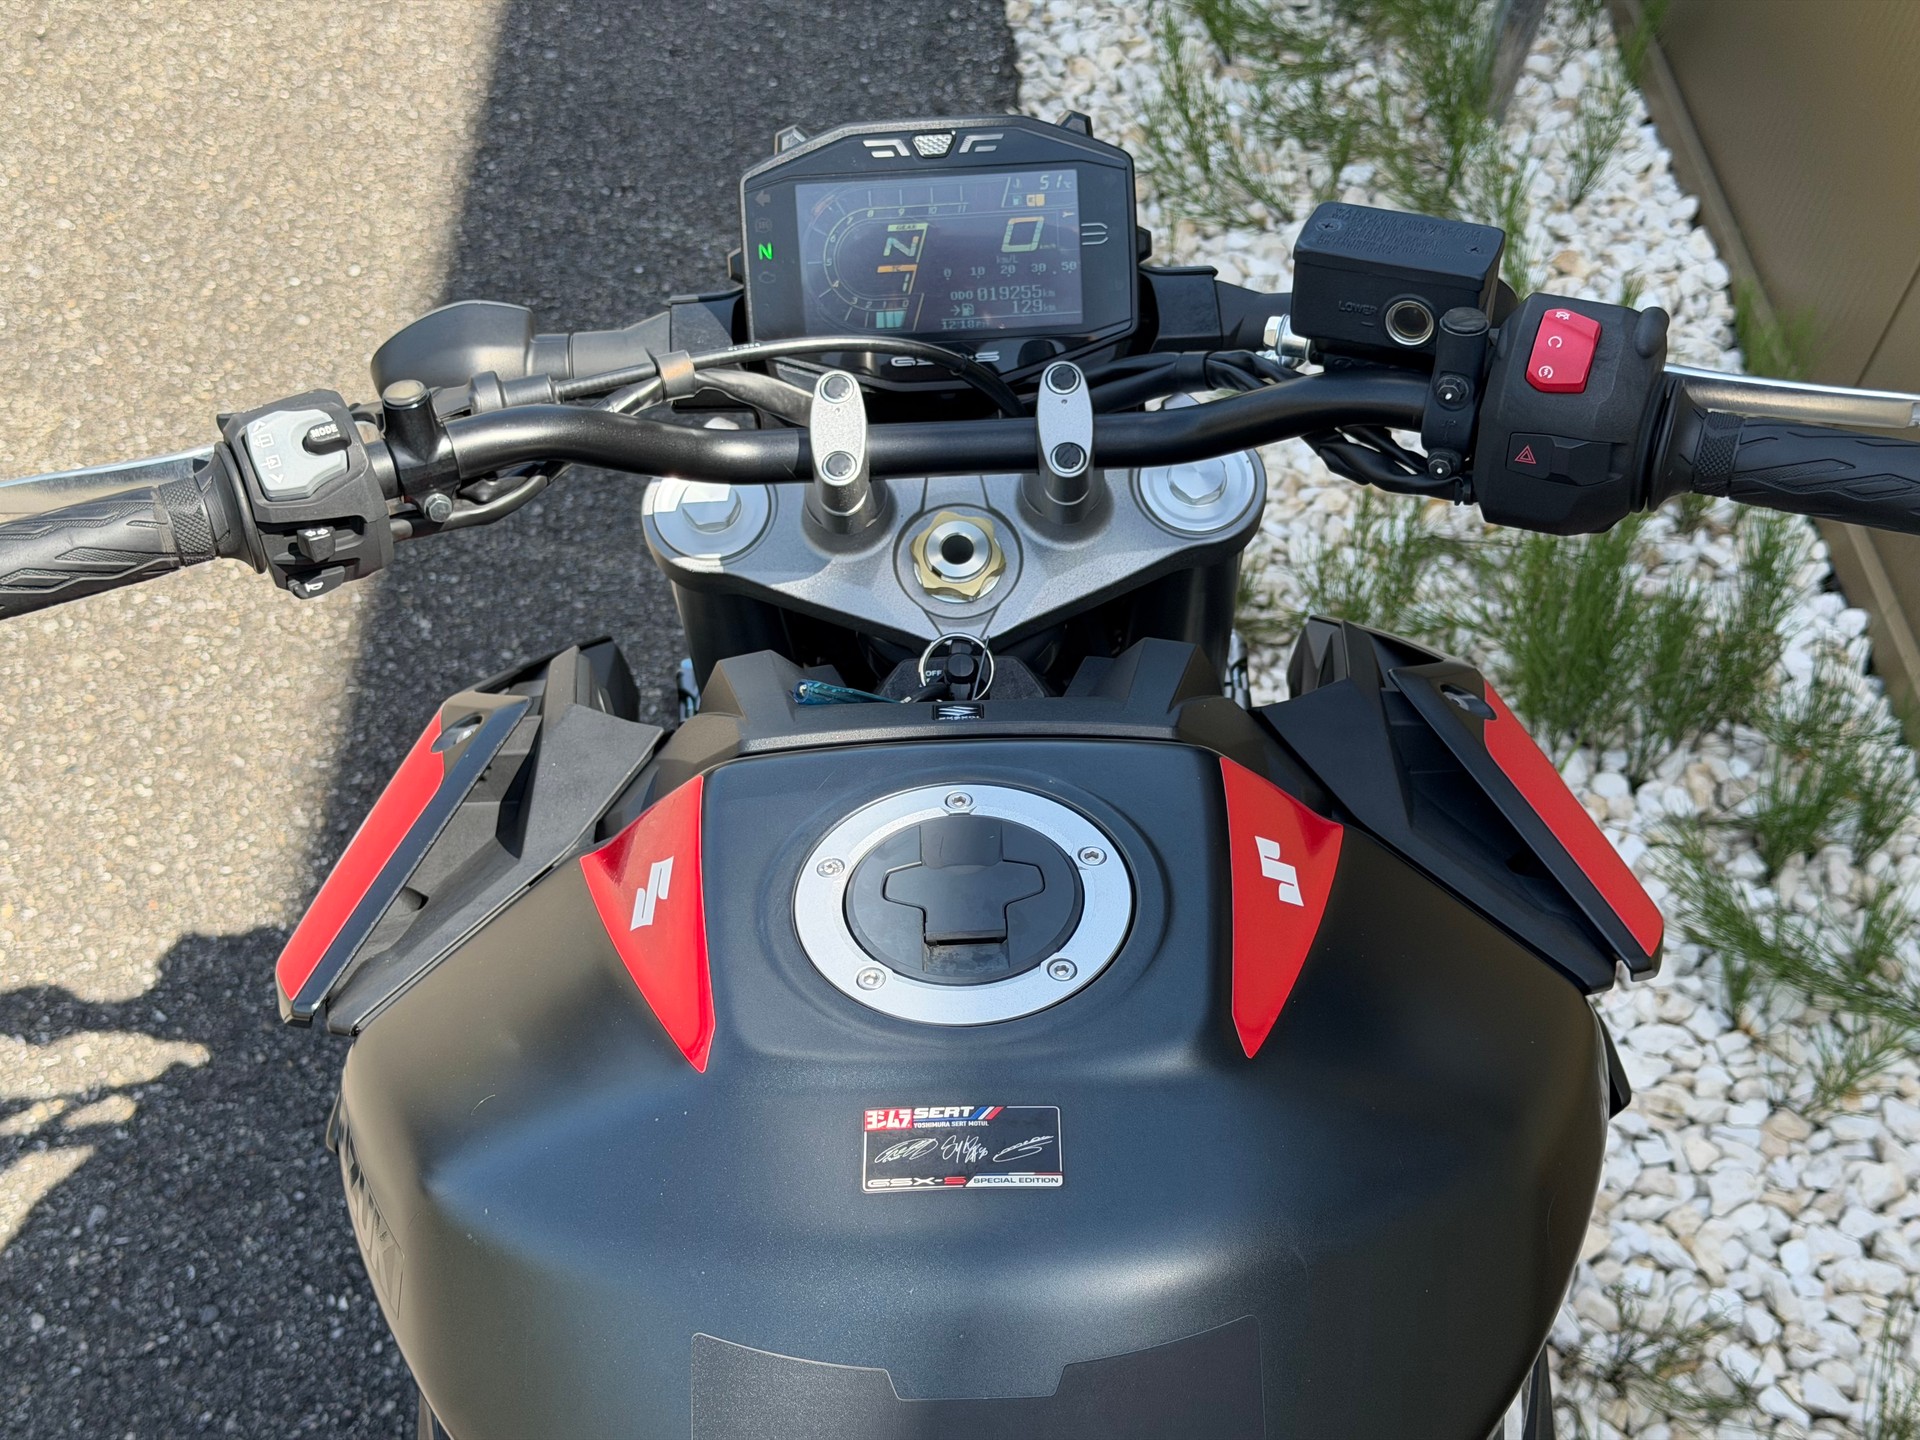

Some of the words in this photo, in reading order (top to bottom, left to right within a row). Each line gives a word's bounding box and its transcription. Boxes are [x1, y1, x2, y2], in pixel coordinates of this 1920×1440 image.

[867, 208, 875, 218] 8
[927, 205, 938, 215] 10
[957, 205, 967, 213] 11
[829, 235, 837, 243] 6
[1001, 216, 1044, 253] 0
[758, 242, 773, 260] N
[883, 235, 920, 257] N
[943, 267, 952, 278] 0
[970, 266, 986, 276] 10
[1000, 264, 1016, 275] 20
[1031, 262, 1047, 273] 30
[1061, 261, 1077, 271] 50
[950, 290, 974, 301] ODO
[865, 301, 873, 309] 2
[1338, 300, 1378, 315] LOWER
[310, 424, 338, 438] MODE
[914, 1106, 975, 1119] SERT
[866, 1110, 912, 1129] ヨシムラ
[867, 1176, 967, 1187] GSX-S
[973, 1176, 1017, 1184] SPECIAL
[1018, 1176, 1059, 1184] EDITION
